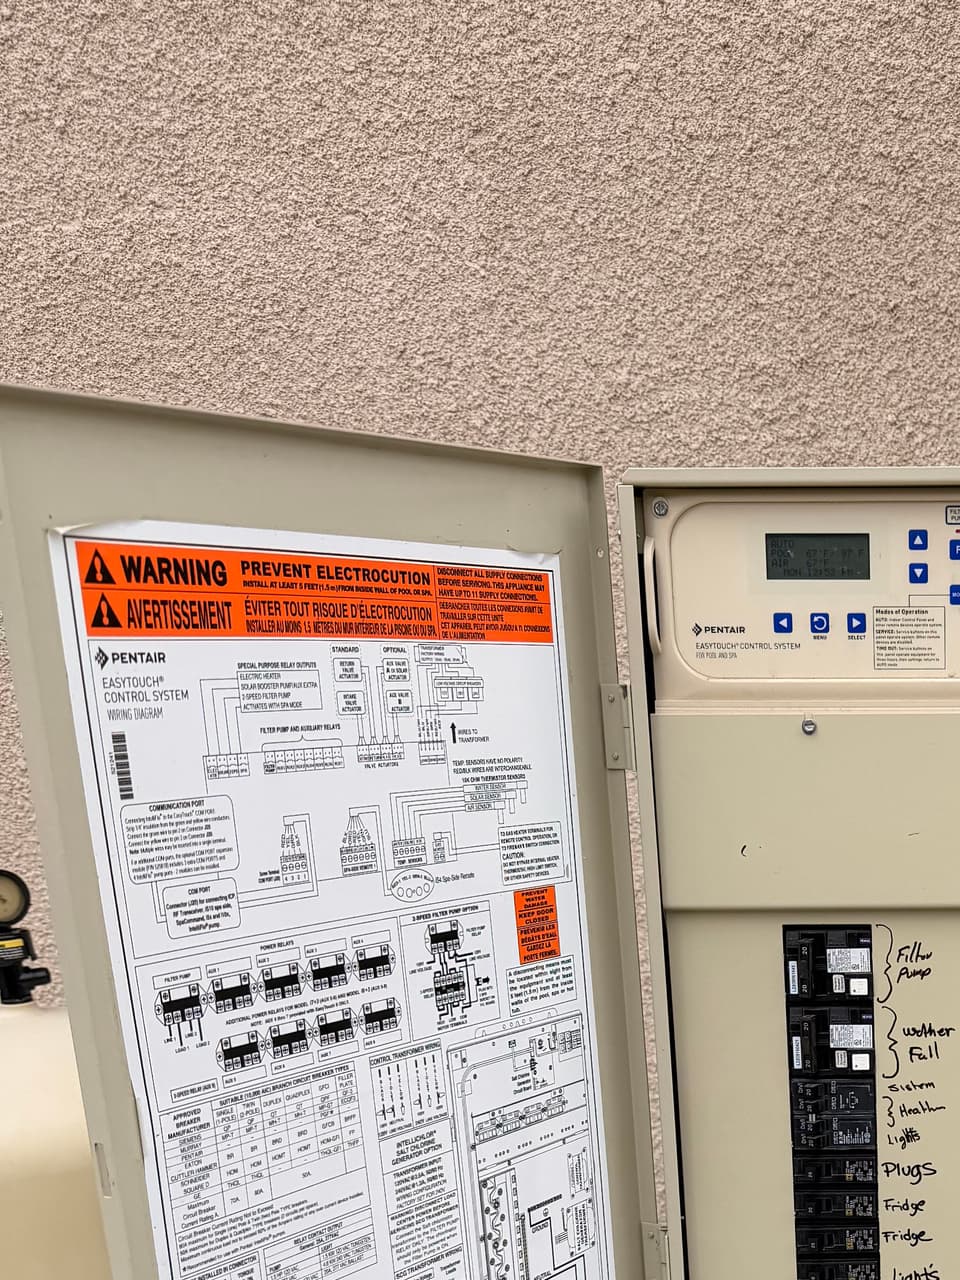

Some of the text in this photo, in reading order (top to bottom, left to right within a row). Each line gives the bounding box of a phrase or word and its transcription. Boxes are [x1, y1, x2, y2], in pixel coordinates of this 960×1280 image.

[120, 555, 228, 587] WARNING
[241, 560, 431, 585] PREVENT ELECTROCUTION
[437, 568, 473, 576] DISCONNECT
[486, 571, 505, 579] SUPPLY
[507, 572, 543, 581] CONNECTIONS
[243, 580, 268, 588] INSTALL
[438, 578, 461, 586] BEFORE
[493, 581, 505, 589] THIS
[506, 582, 534, 590] APPLIANCE
[128, 598, 232, 630] AVERTISSEMENT
[244, 595, 281, 616] ÉVITER
[283, 601, 310, 616] TOUT
[313, 602, 348, 618] RISQUE
[351, 600, 432, 621] D'ÉLECTROCUTION
[705, 626, 745, 634] PENTAIR
[112, 652, 166, 665] PENTAIR
[102, 676, 165, 689] EASYTOUCH®
[104, 690, 189, 703] CONTROL SYSTEM
[107, 707, 164, 721] WIRING DIAGRAM
[149, 800, 205, 812] COMMUNICATION PORT
[521, 889, 548, 897] PREVENT
[524, 900, 548, 909] DAMAGE
[537, 908, 554, 917] DOOR
[525, 916, 549, 925] CLOSED
[260, 940, 294, 951] POWER RELAYS
[802, 947, 808, 955] 20
[164, 975, 178, 983] FILTER
[802, 985, 808, 993] 20
[803, 1022, 809, 1031] 20
[805, 1060, 811, 1068] 20
[173, 1108, 202, 1121] APPROVED
[176, 1117, 201, 1129] BREAKER
[168, 1123, 211, 1140] MANUFACTURER
[392, 1144, 442, 1166] GENERATOR OPTION
[396, 1146, 410, 1157] SALT
[882, 1162, 937, 1185] Plugs
[883, 1199, 926, 1217] Fridge
[882, 1229, 933, 1247] Fridge
